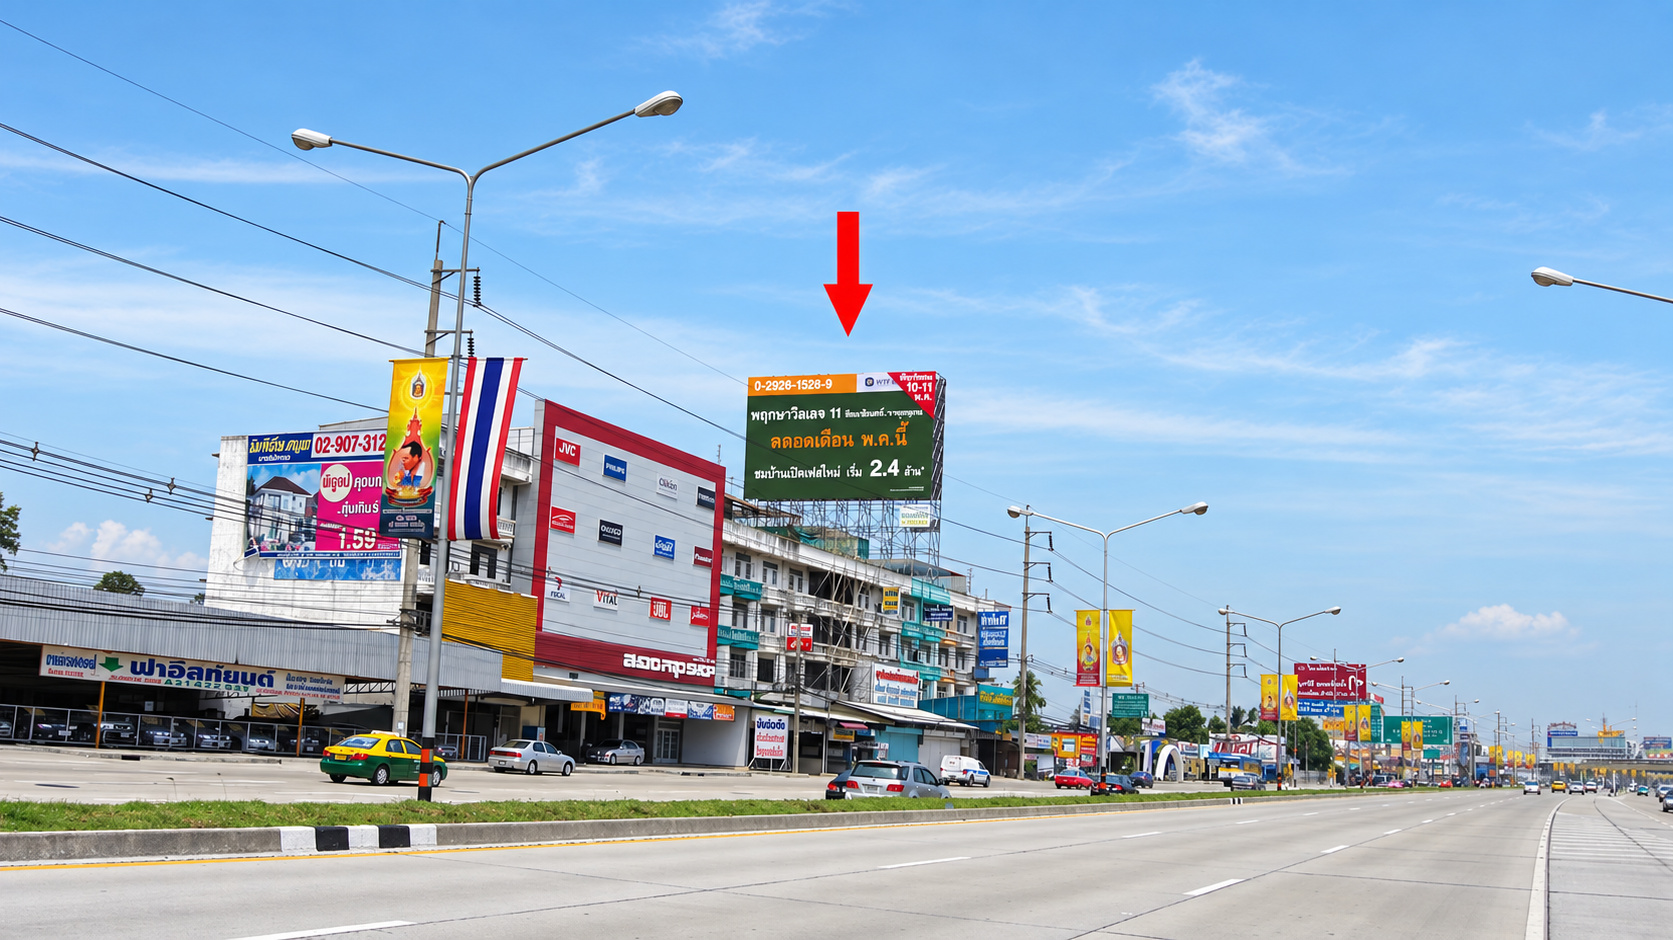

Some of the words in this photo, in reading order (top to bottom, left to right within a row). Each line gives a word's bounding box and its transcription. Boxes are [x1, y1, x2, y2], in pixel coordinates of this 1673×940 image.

[906, 382, 932, 393] 10-11
[830, 407, 841, 419] 11
[559, 442, 576, 457] JVC
[870, 459, 900, 477] 2.4
